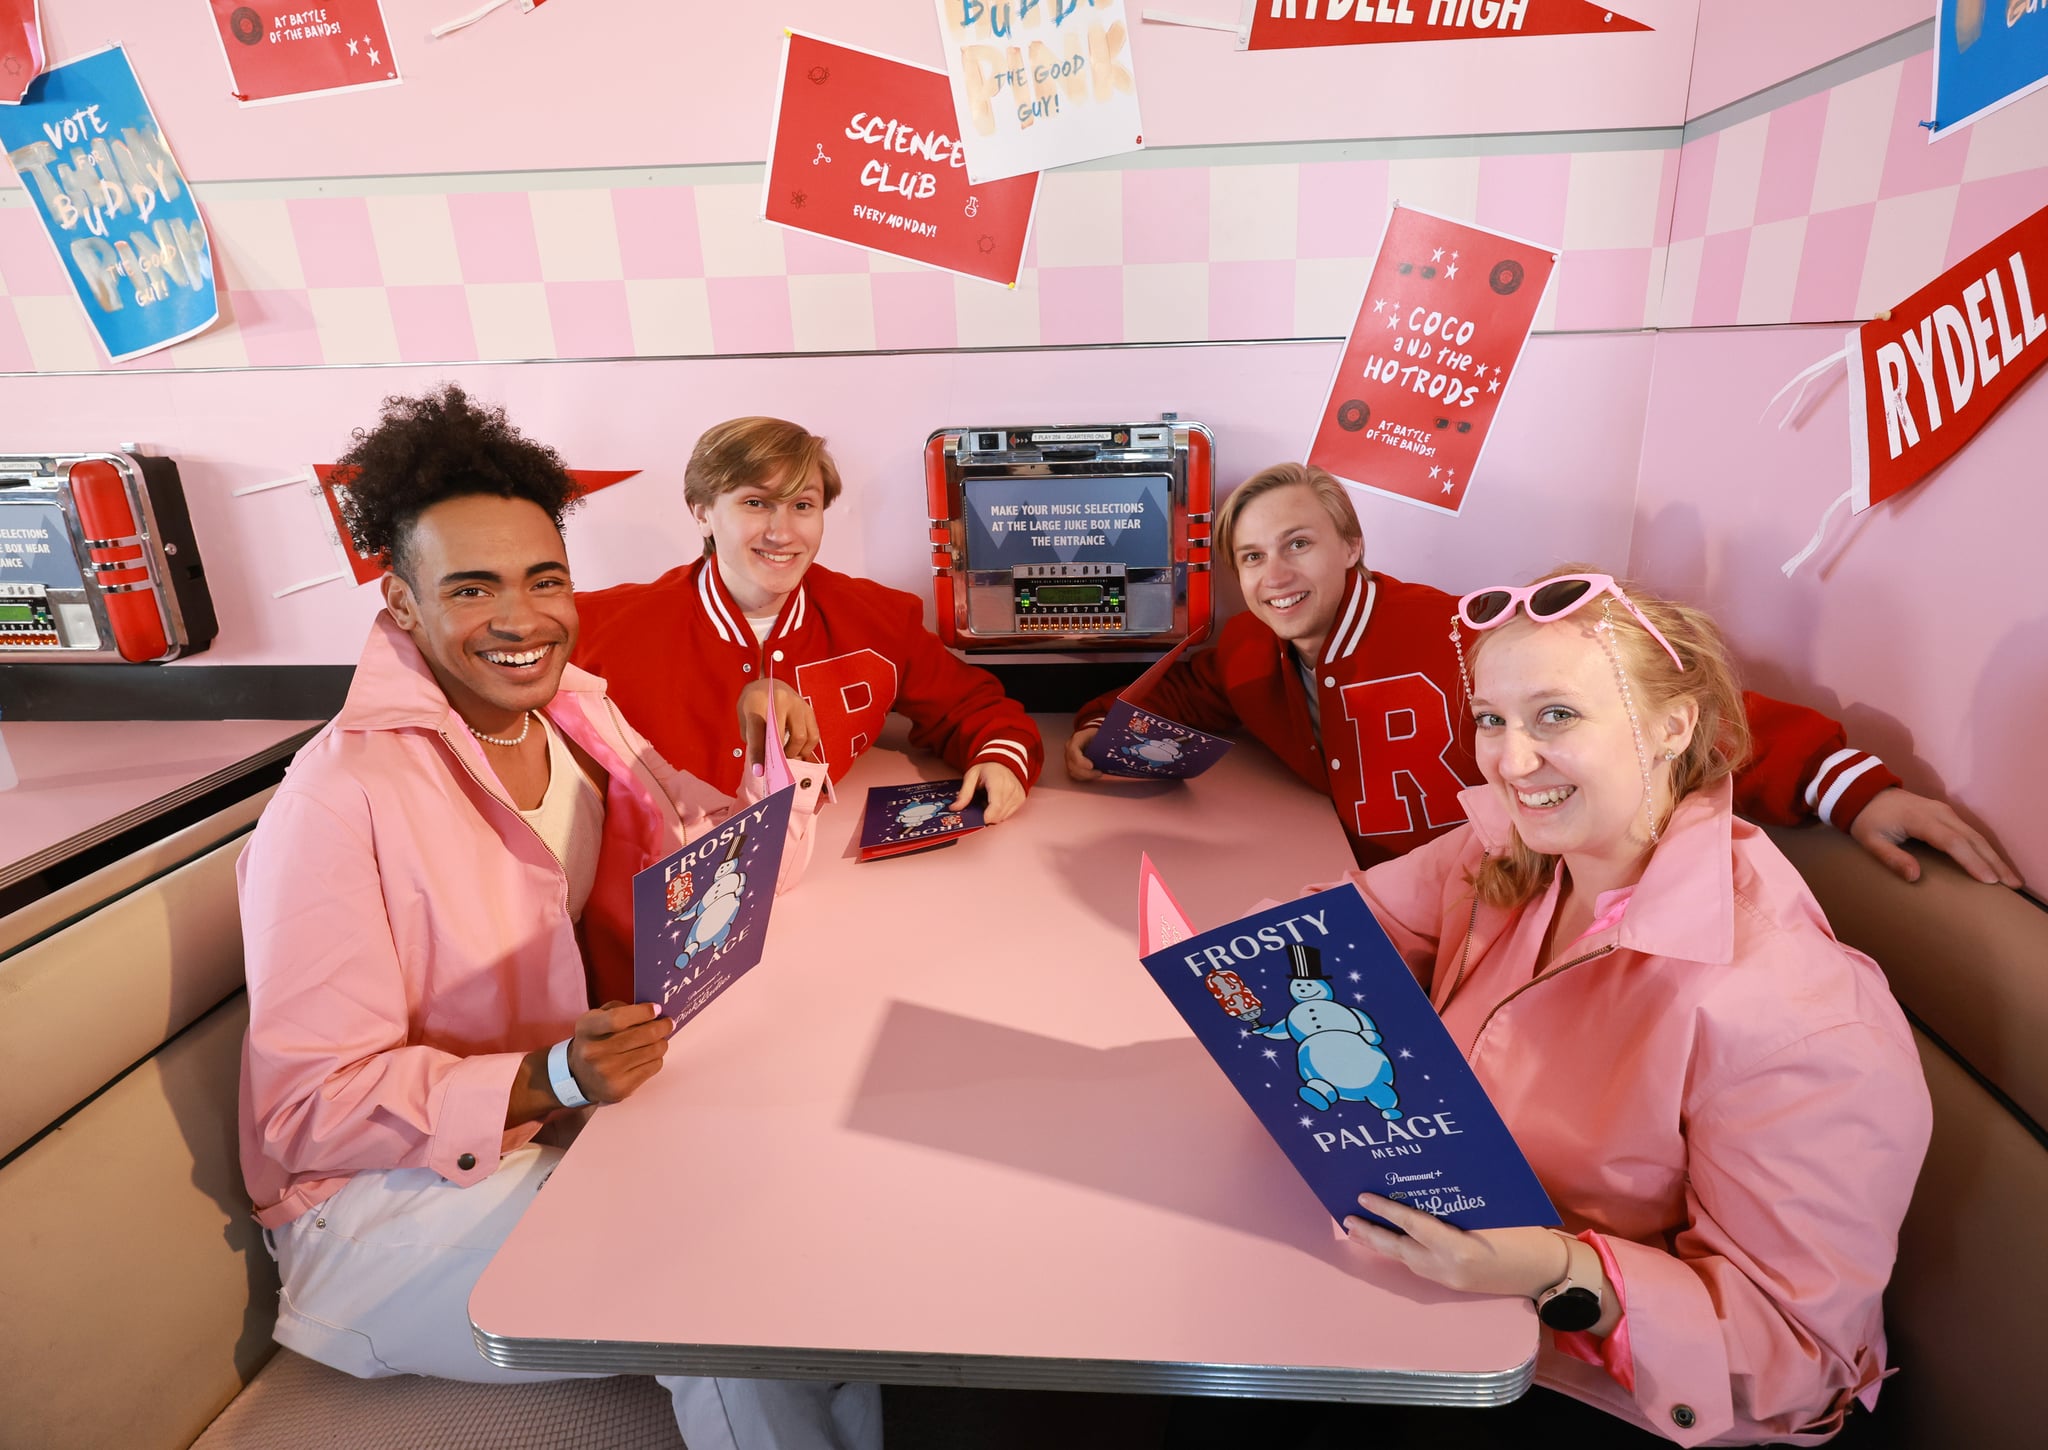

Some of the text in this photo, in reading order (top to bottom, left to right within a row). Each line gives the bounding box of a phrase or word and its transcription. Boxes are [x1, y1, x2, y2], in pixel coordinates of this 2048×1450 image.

[269, 21, 341, 44] OF THE BANDS!
[274, 8, 327, 29] AT BATTLE
[960, 0, 1096, 40] BUD
[960, 20, 1135, 138] PINK
[994, 54, 1085, 90] THE GOOD
[1017, 94, 1060, 123] GUY!
[43, 104, 109, 150] VOTE
[845, 112, 967, 168] SCIENCE
[75, 150, 105, 169] FOR
[860, 159, 937, 200] CLUB
[54, 159, 171, 238] BUDDY
[853, 204, 938, 238] EVERY MONDAY!
[106, 244, 176, 282] THE GOOD
[135, 279, 170, 307] GUY!
[1408, 306, 1475, 346] COCO
[1875, 250, 2048, 461] RYDELL
[1362, 354, 1480, 408] HOTRODS
[1366, 429, 1436, 458] OF THE BANDS!
[1378, 419, 1432, 443] AT BATTLE
[991, 503, 1144, 516] MAKE YOUR MUSIC SELECTIONS
[991, 519, 1141, 531] AT THE LARGE JUKE BOX NEAR
[0, 529, 49, 539] ELECTIONS
[4, 543, 24, 553] BOX
[1031, 535, 1105, 546] THE ENTRANCE
[1132, 710, 1212, 744] FROSTY
[1340, 671, 1472, 837] R
[664, 804, 769, 883] FROSTY
[880, 823, 964, 843] FROSTY
[1183, 909, 1331, 978] FROSTY
[664, 924, 751, 1004] PALACE
[1312, 1111, 1464, 1153] PALACE
[1371, 1143, 1422, 1159] MENU
[1385, 1169, 1443, 1186] Paramount+
[1426, 1194, 1486, 1216] Ladies
